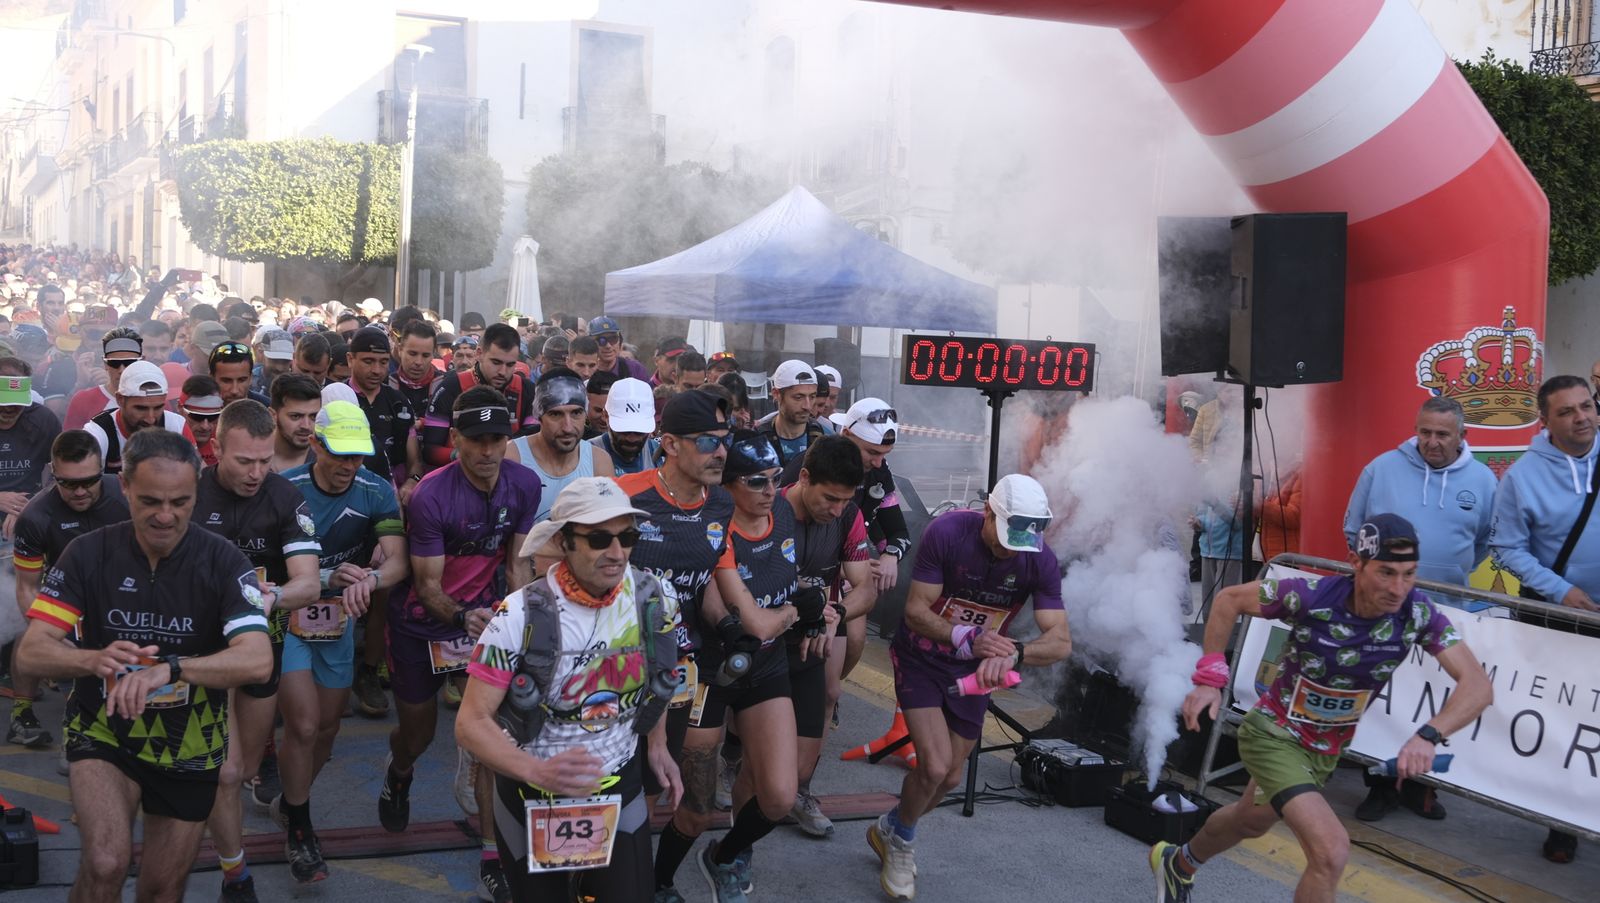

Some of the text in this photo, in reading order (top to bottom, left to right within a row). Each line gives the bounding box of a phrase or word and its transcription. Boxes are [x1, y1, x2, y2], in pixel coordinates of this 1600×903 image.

[910, 340, 1089, 386] 00:00:00
[107, 608, 194, 632] CUELLAR
[306, 605, 331, 620] 31
[959, 609, 988, 626] 38
[118, 632, 154, 640] STONE
[1307, 692, 1355, 710] 368
[555, 819, 594, 840] 43
